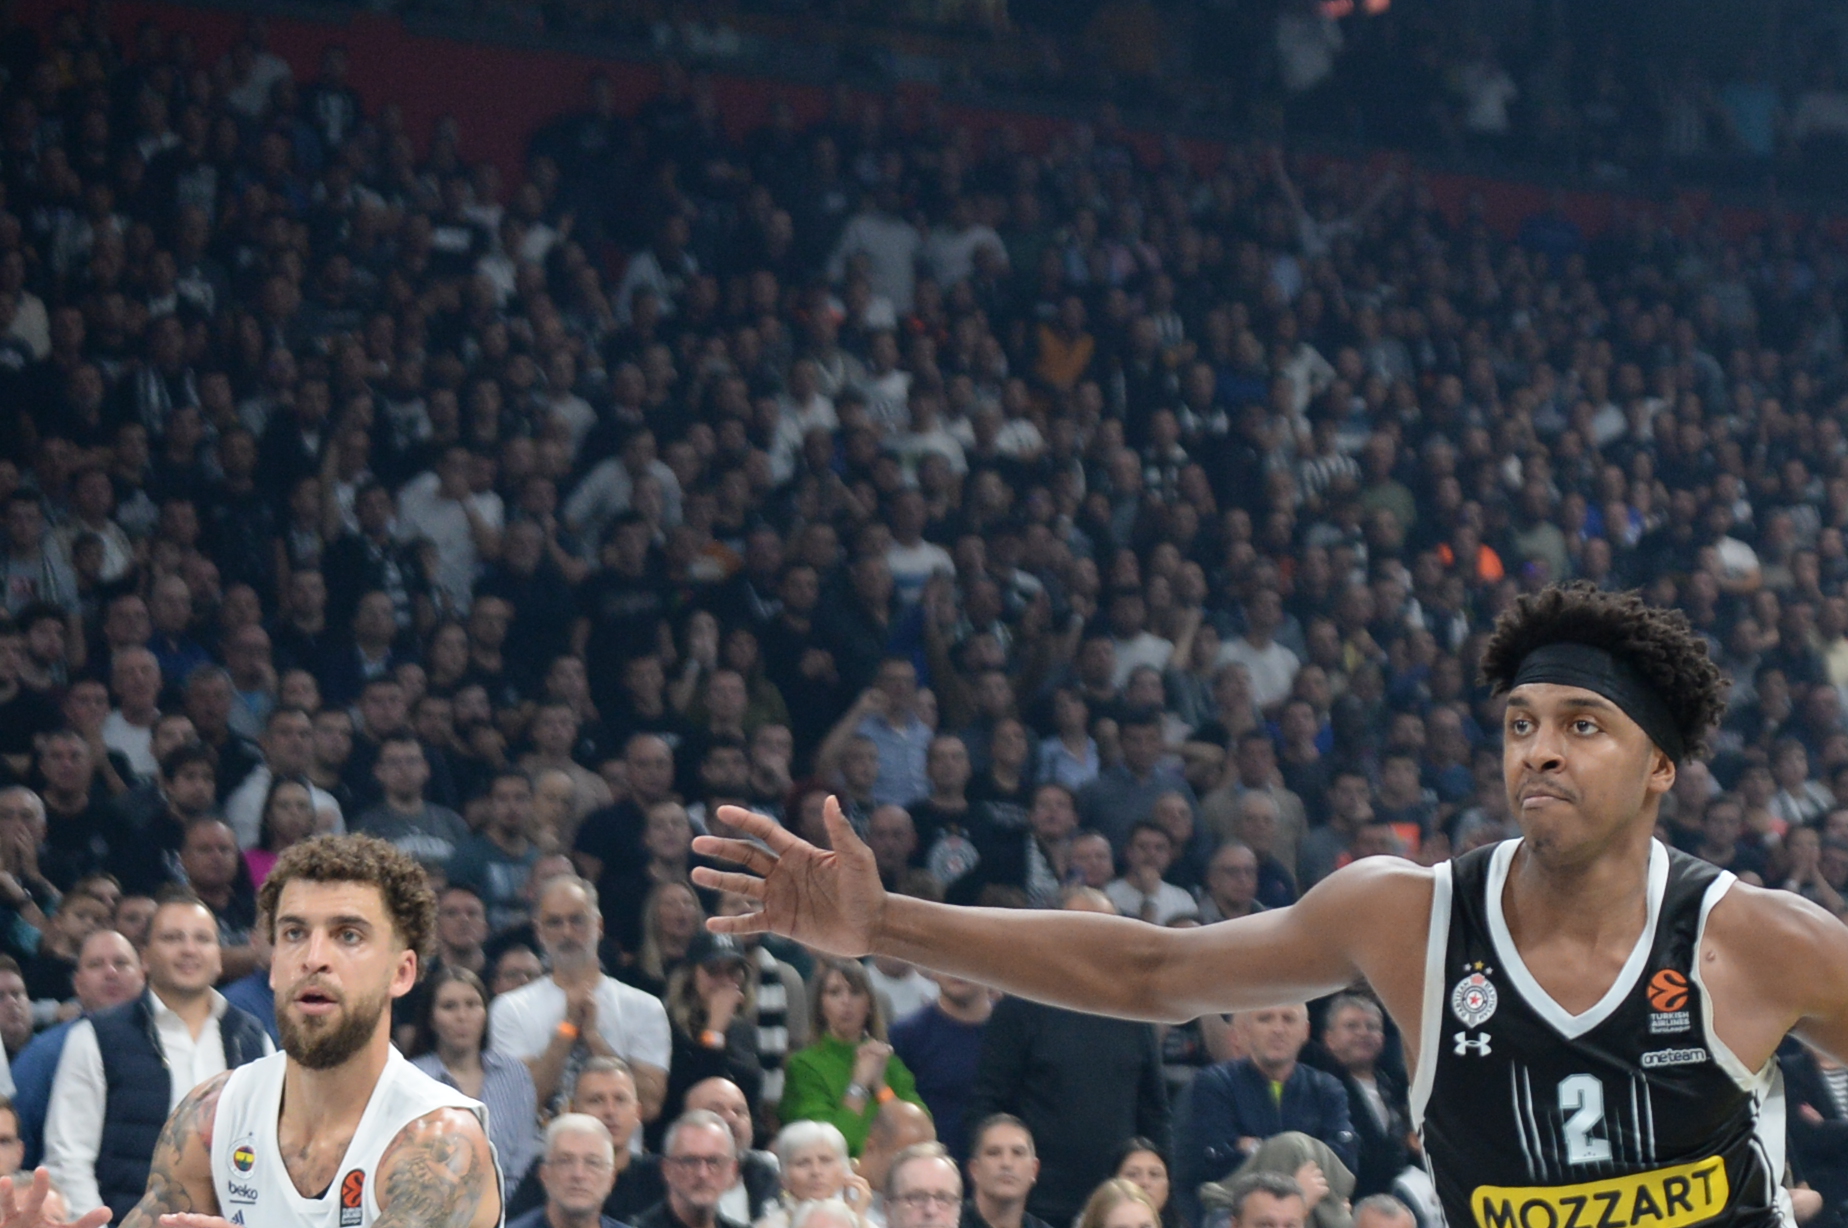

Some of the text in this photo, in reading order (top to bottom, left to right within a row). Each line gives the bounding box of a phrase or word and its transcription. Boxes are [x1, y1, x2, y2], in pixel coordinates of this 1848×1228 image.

[1650, 1011, 1690, 1020] TURKISH
[1651, 1018, 1691, 1027] AIRLINES
[1643, 1048, 1706, 1066] oneteam
[1557, 1074, 1610, 1165] 2
[228, 1179, 258, 1200] beko
